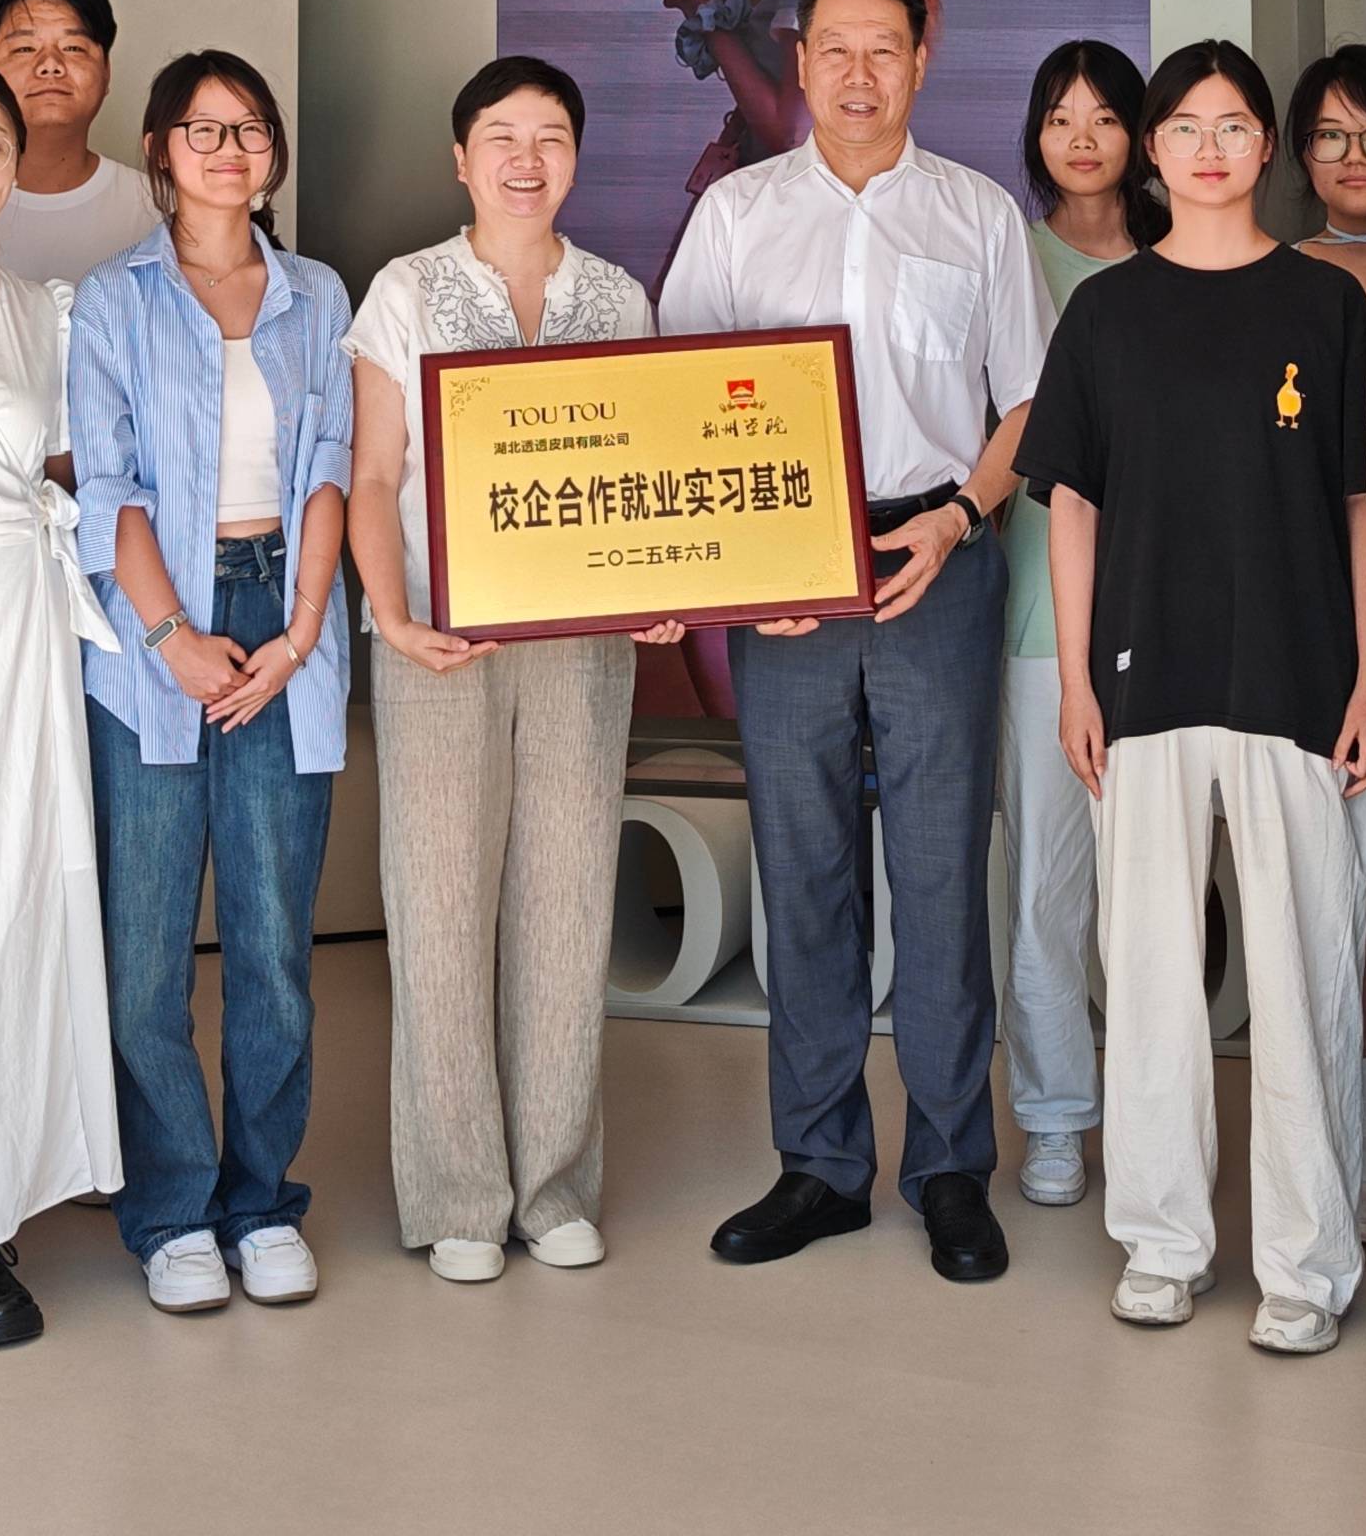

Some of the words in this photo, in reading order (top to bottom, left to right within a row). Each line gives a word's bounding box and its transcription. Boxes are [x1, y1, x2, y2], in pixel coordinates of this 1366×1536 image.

[502, 405, 558, 428] TOU
[561, 401, 617, 424] TOU
[701, 415, 788, 440] 荆州学院
[493, 432, 630, 456] 湖北透透皮具有限公司
[488, 459, 813, 533] 校企合作就业实习基地
